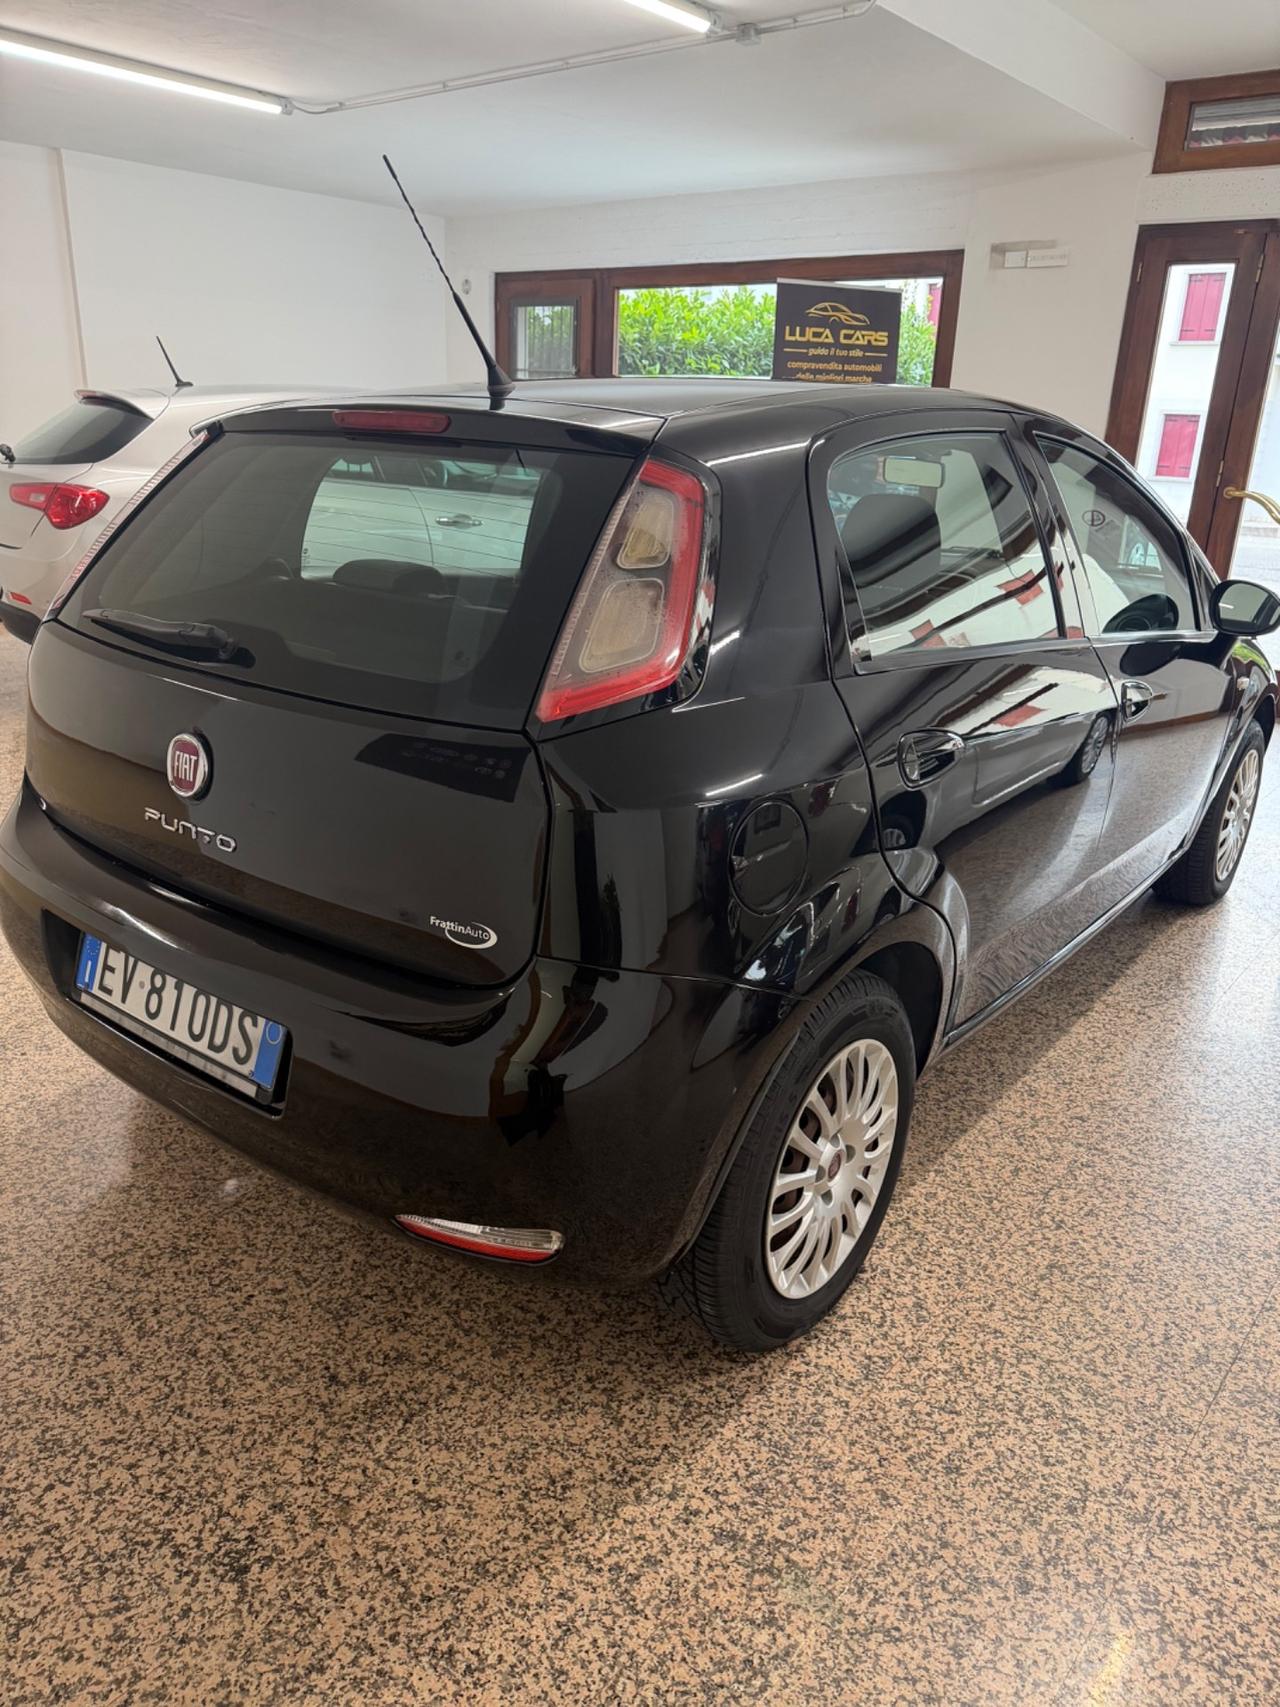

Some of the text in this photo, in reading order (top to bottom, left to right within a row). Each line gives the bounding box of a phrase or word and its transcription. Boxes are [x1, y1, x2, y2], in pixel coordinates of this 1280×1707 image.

[784, 325, 888, 346] LUCA CARS
[830, 347, 835, 356] il
[836, 348, 848, 356] tuo
[849, 348, 864, 357] stile
[787, 361, 882, 372] compravendita automobili
[815, 373, 844, 381] migliori
[845, 374, 872, 383] marche
[173, 751, 197, 782] FIAT
[144, 807, 236, 852] PUNTO
[429, 915, 490, 940] FrattinAuto
